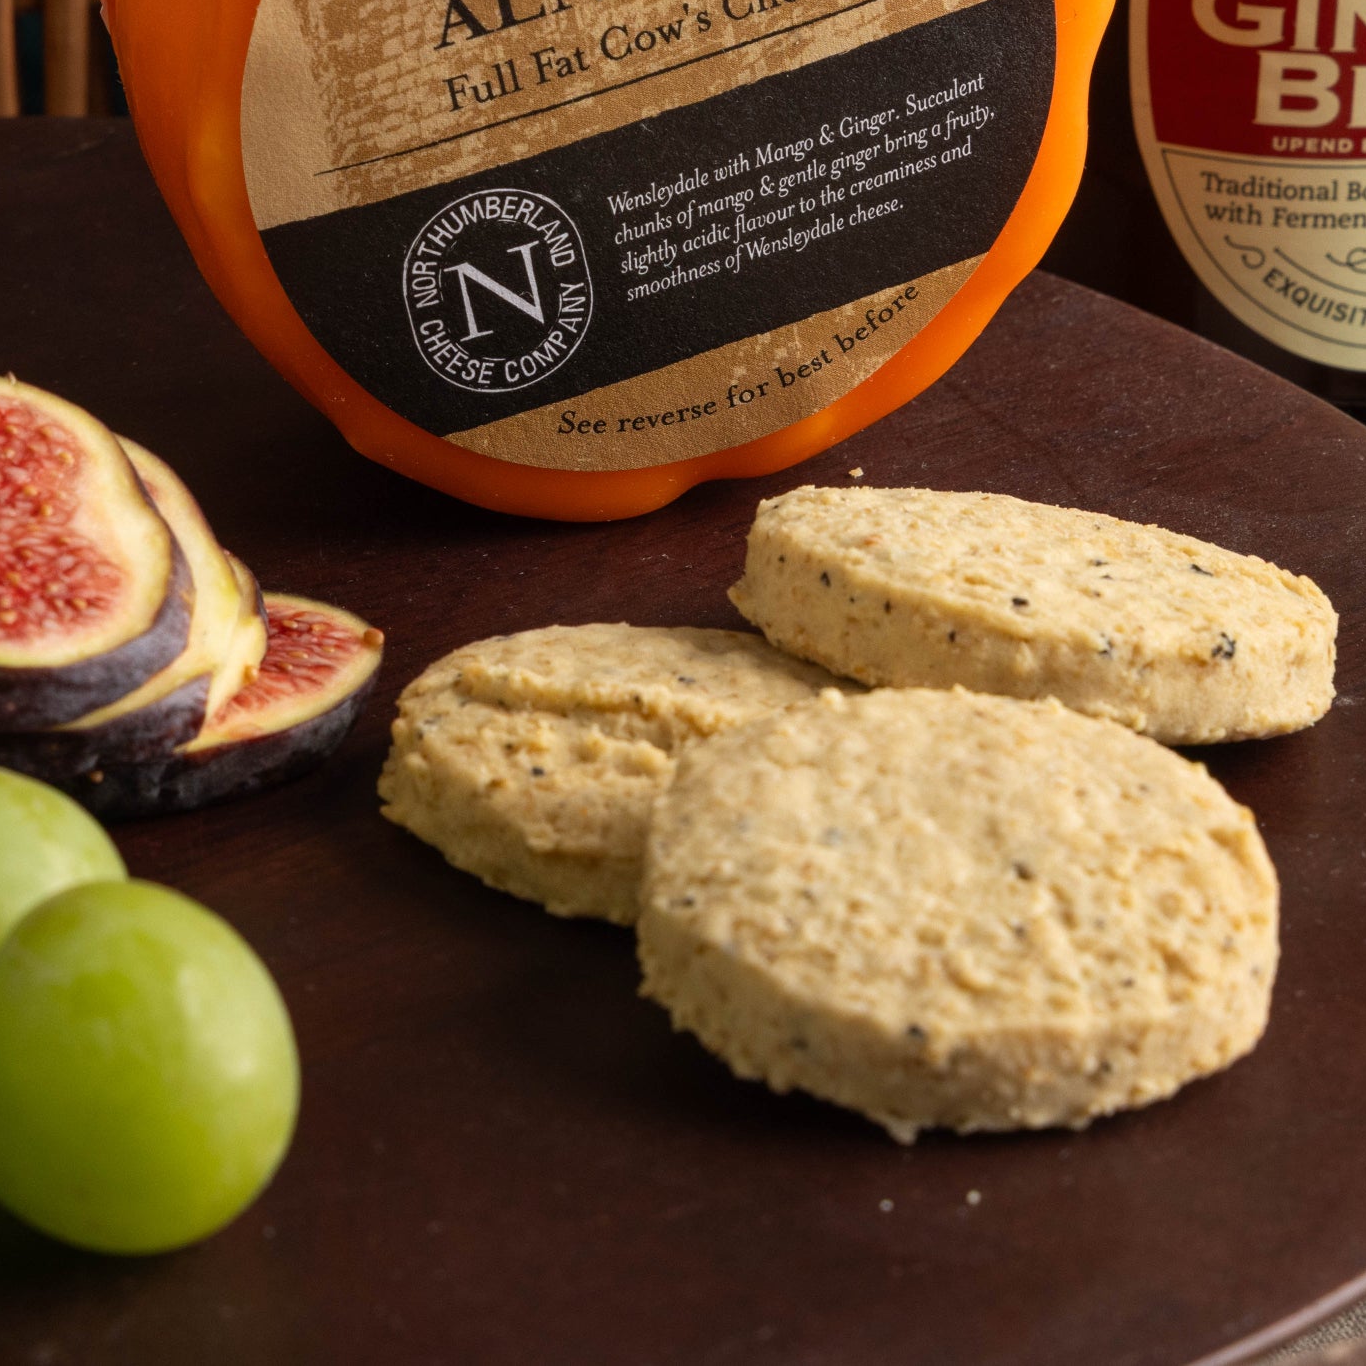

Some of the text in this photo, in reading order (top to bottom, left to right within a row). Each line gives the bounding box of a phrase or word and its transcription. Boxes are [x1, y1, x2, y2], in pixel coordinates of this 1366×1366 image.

[443, 62, 523, 114] Full
[534, 46, 591, 96] Fat
[600, 2, 713, 62] Cow's
[608, 73, 985, 215] Wensleydale with Mango & Ginger. Succulent
[614, 103, 995, 245] chunks of mango & gentle ginger bring a fruity,
[1200, 171, 1339, 202] Traditional
[1272, 136, 1355, 154] UPEND
[410, 195, 577, 308] NORTHUMBERLAND
[621, 135, 973, 277] slightly acidic flavour to the creaminess and
[627, 199, 905, 302] smoothness of Wensleydale cheese.
[1205, 201, 1263, 226] with
[418, 283, 587, 385] CHEESE COMPANY
[443, 239, 546, 343] N
[558, 283, 921, 436] See reverse for best before
